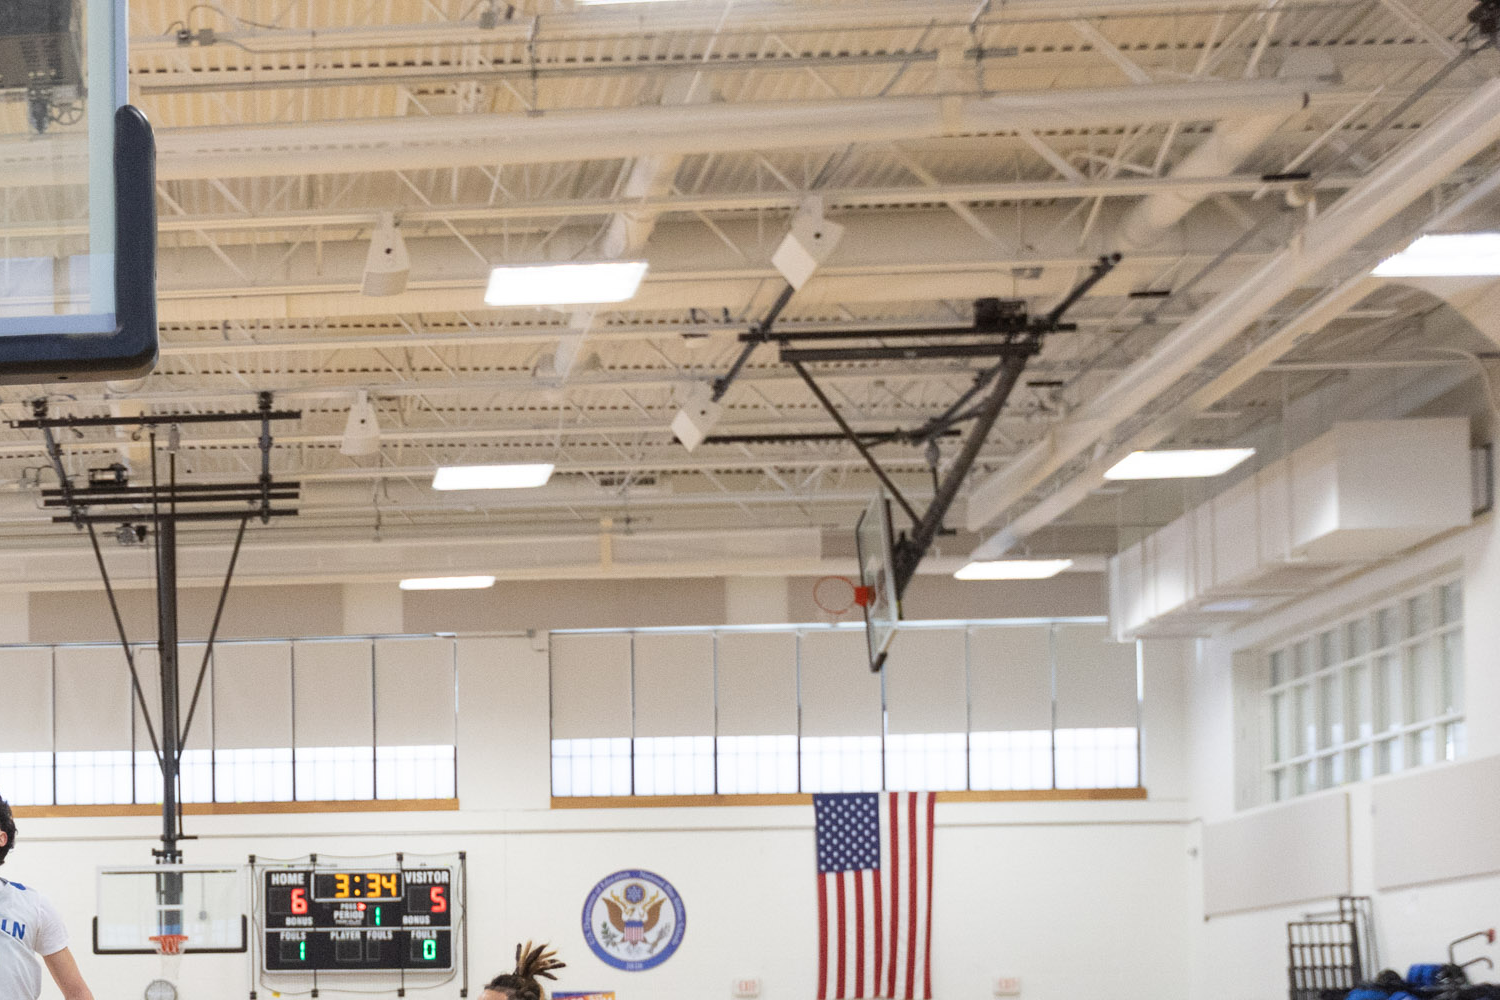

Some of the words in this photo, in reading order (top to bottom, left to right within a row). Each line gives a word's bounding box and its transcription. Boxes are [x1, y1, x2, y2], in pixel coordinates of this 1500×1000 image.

[271, 872, 305, 886] HOME
[404, 871, 449, 884] VISITOR
[334, 873, 397, 898] 3:34
[291, 888, 308, 914] 6
[430, 886, 447, 913] 5
[285, 916, 313, 926] BONUS
[333, 910, 364, 920] PERIOD
[375, 906, 381, 926] 1
[402, 915, 430, 925] BONUS
[280, 931, 306, 941] FOULS
[330, 930, 361, 940] PLAYER
[366, 930, 393, 940] FOULS
[411, 930, 437, 940] FOULS
[300, 941, 306, 960] 1
[423, 939, 436, 960] 0
